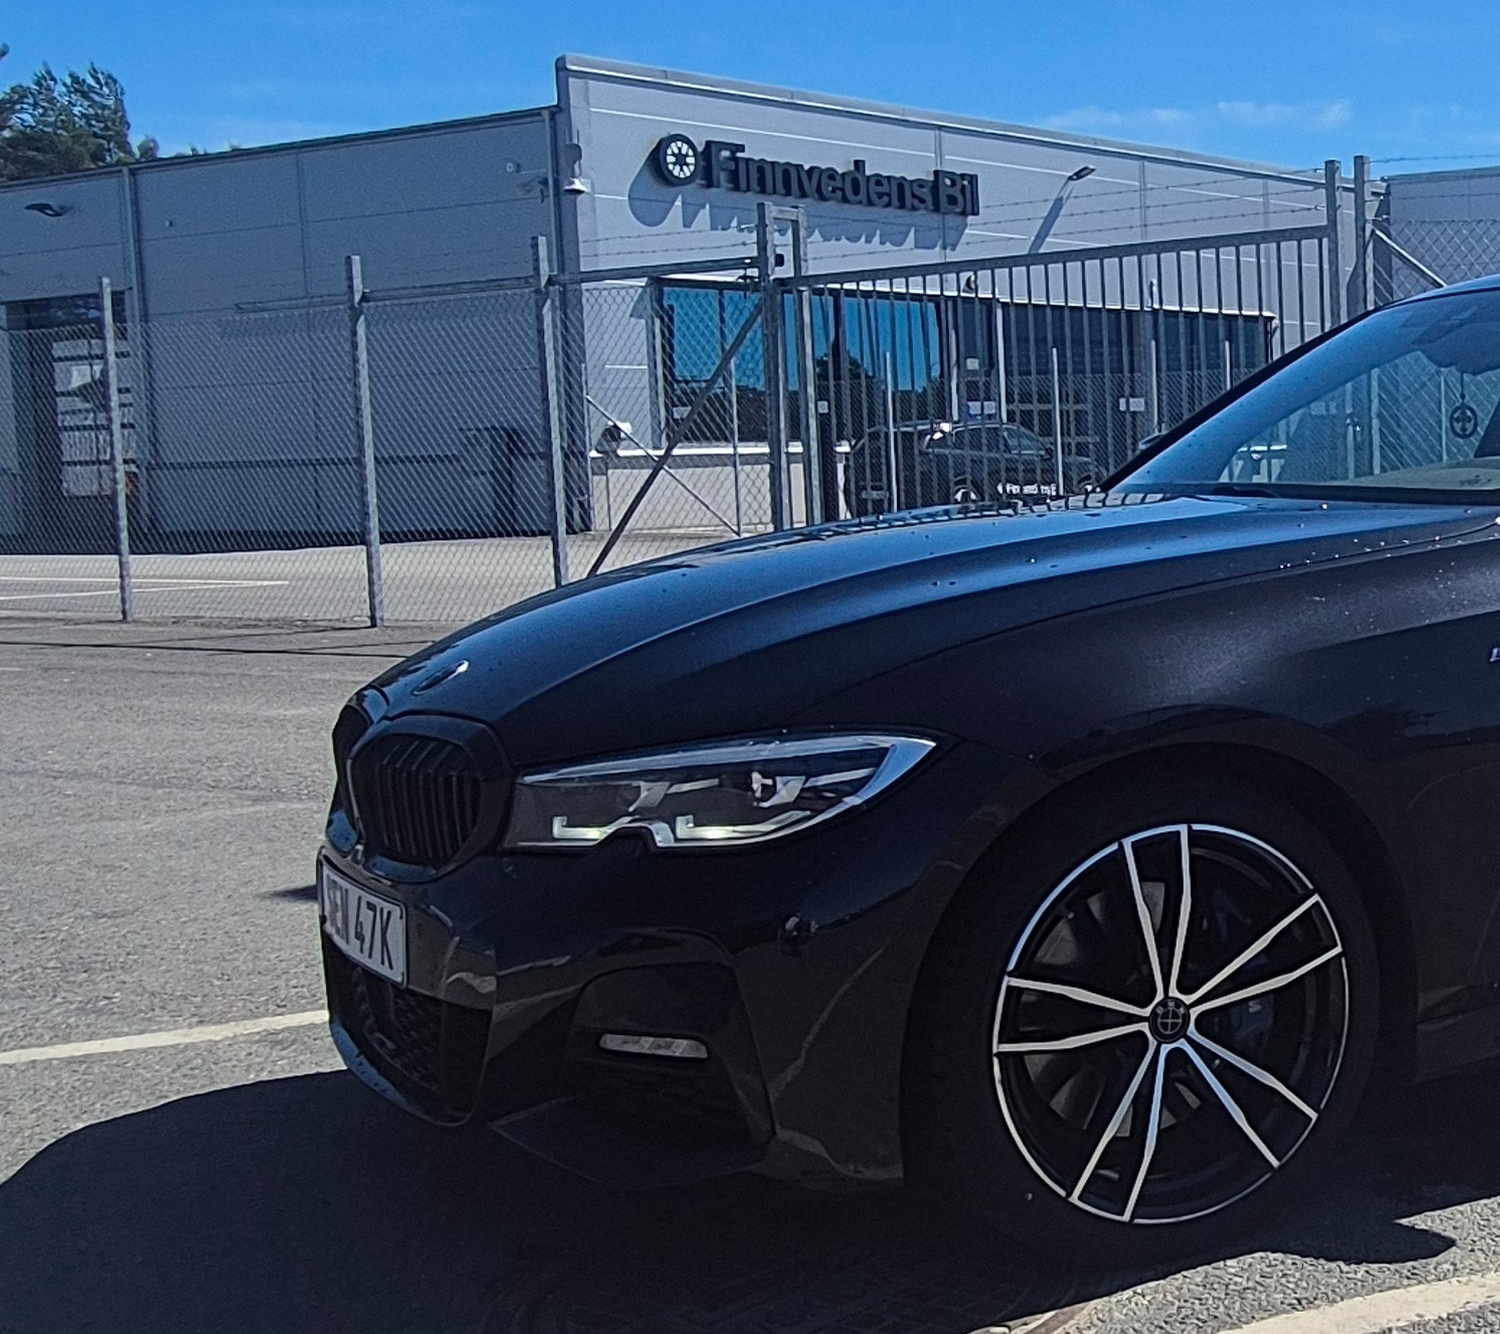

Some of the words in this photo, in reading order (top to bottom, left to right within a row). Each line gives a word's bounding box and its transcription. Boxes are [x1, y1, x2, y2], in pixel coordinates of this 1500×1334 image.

[705, 140, 935, 212] Finnvedens
[934, 169, 980, 216] Bil
[354, 895, 394, 971] 47K
